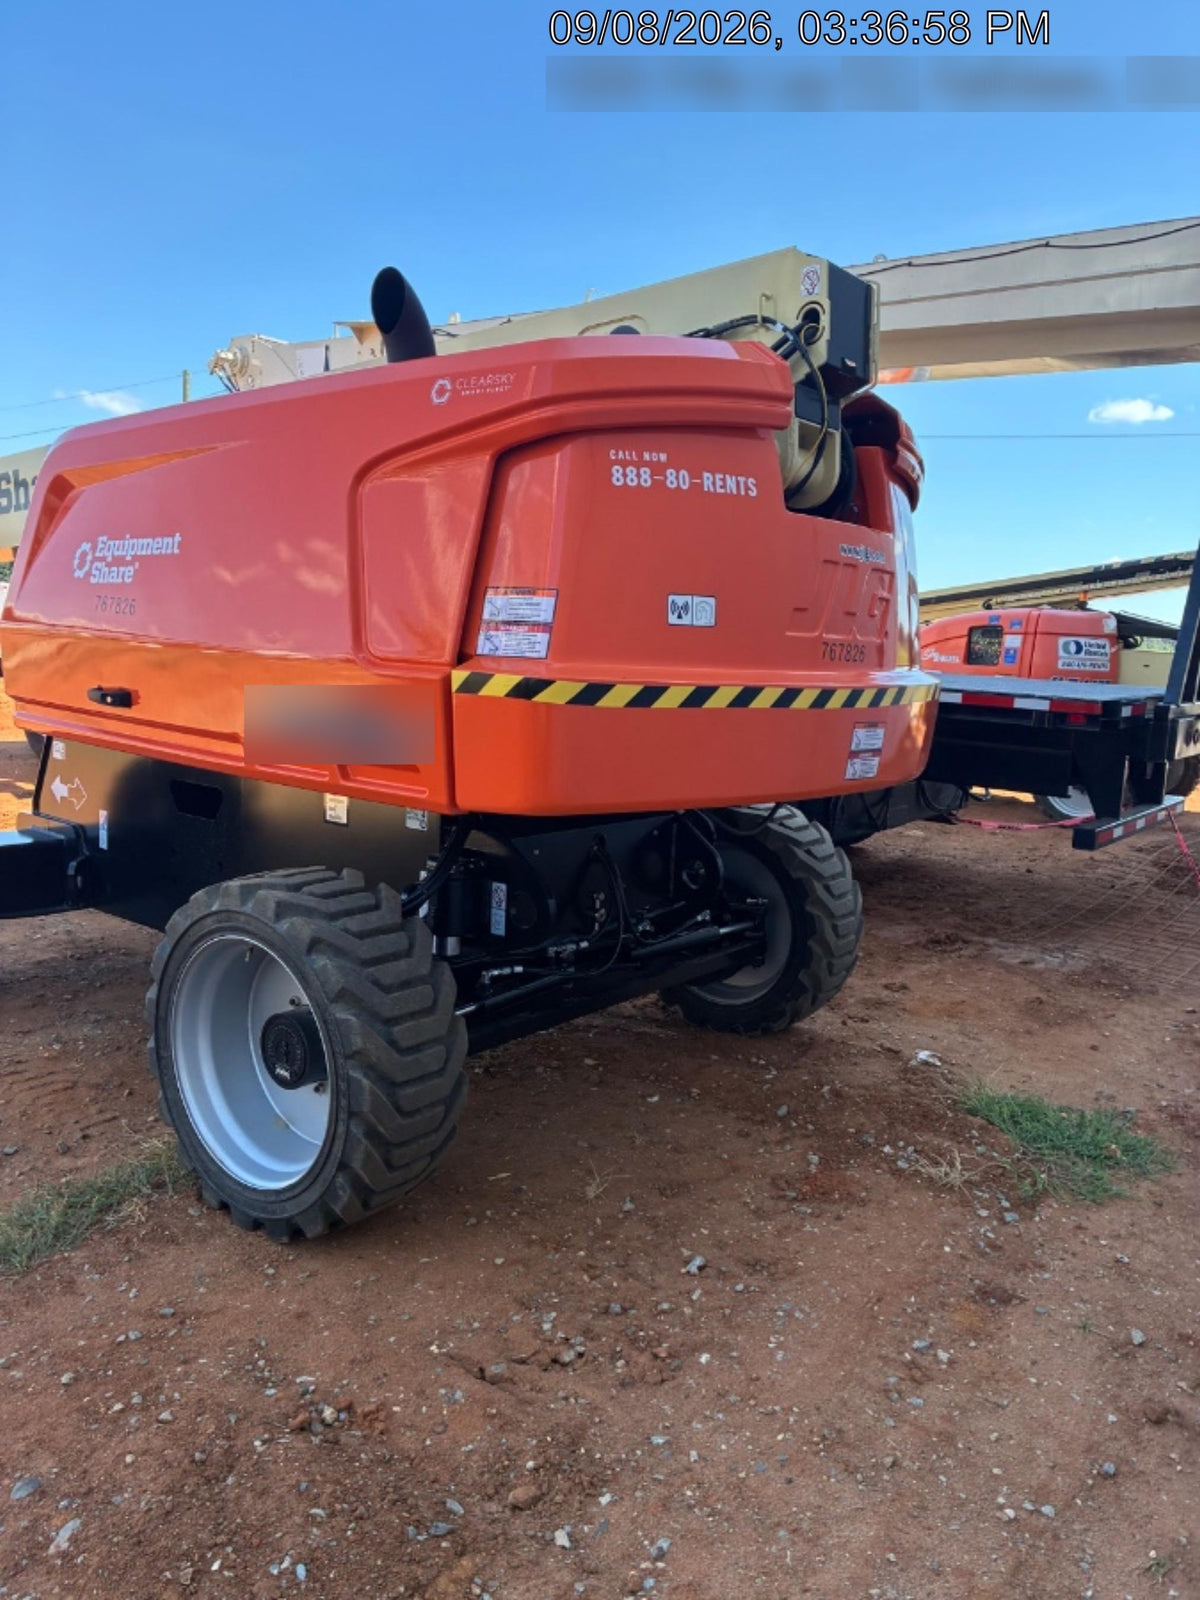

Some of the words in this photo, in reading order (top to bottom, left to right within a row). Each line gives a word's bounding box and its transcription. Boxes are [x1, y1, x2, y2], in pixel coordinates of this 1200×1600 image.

[609, 449, 639, 461] CALL
[643, 451, 667, 462] NOW
[611, 465, 758, 497] 888-80-RENTS
[95, 532, 182, 562] Equipment
[90, 561, 134, 584] Share
[95, 595, 137, 616] 767826
[822, 641, 866, 662] 767826
